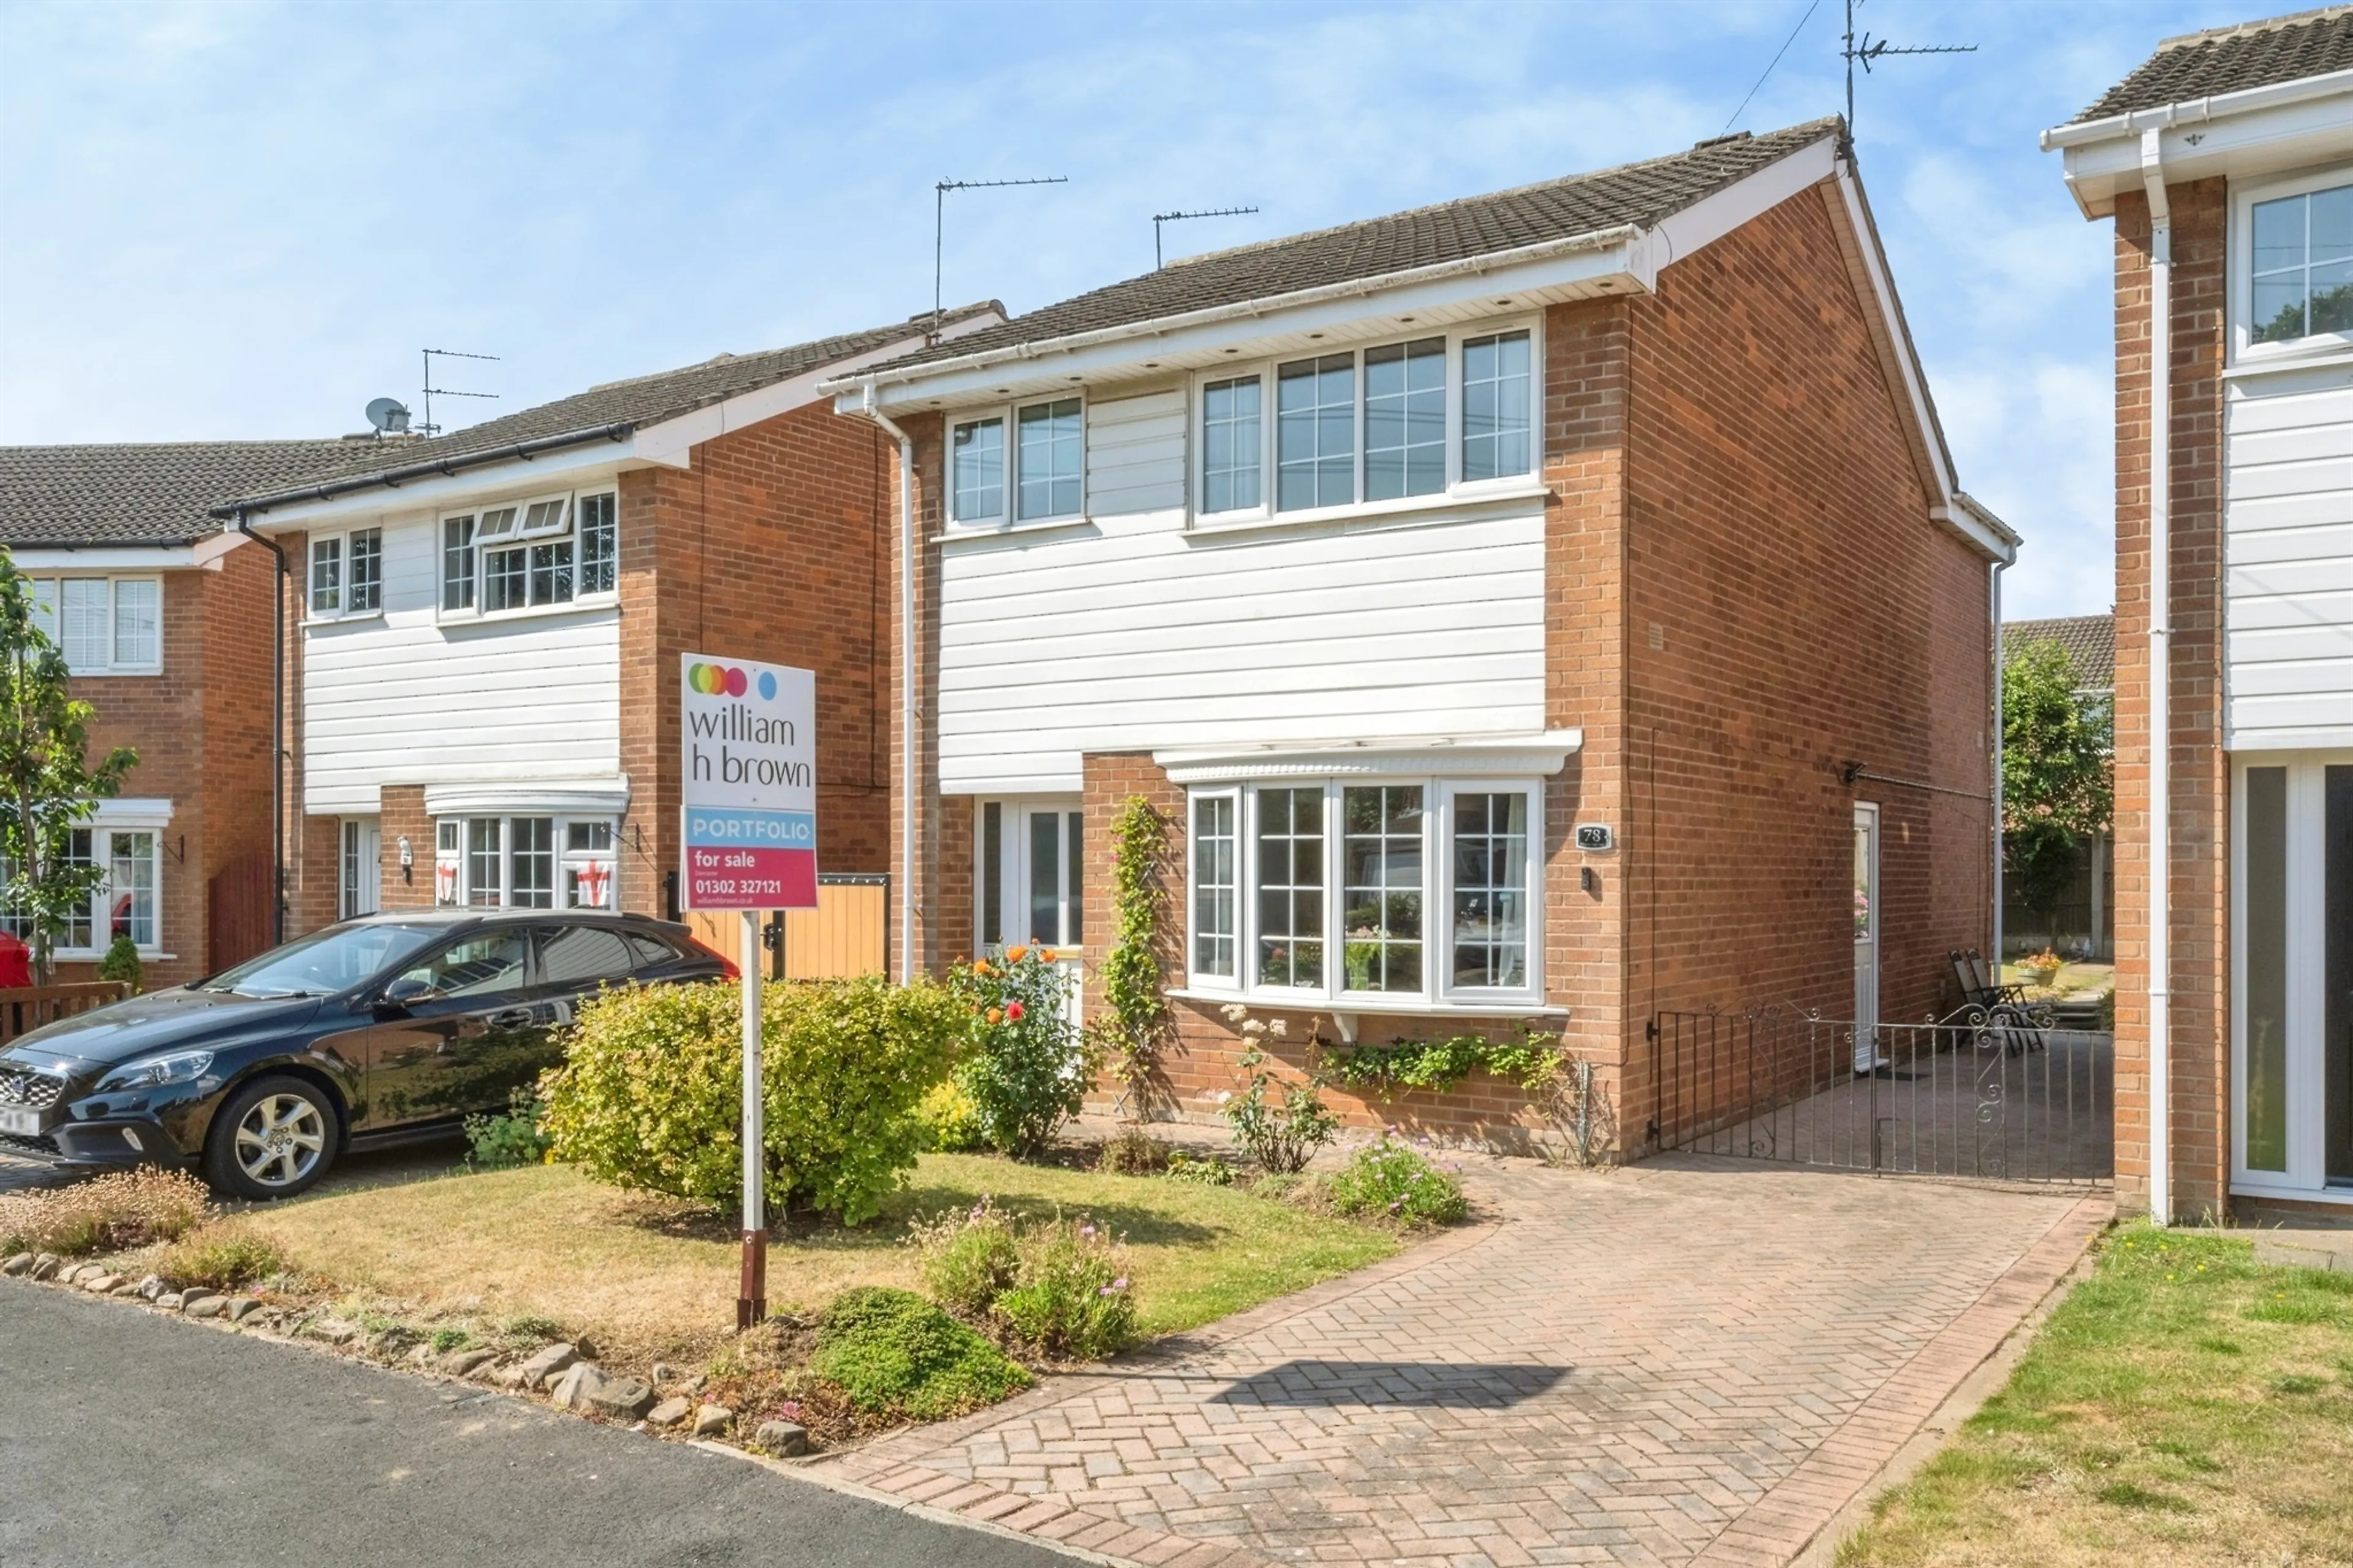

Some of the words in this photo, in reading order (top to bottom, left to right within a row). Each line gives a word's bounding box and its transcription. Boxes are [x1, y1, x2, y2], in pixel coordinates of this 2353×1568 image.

[689, 703, 794, 746] william
[693, 743, 710, 781] h
[722, 745, 810, 787] brown
[693, 819, 810, 840] PORTFOLIO
[1584, 829, 1601, 842] 78
[695, 850, 720, 867] for
[724, 851, 755, 867] sale
[696, 880, 735, 894] 01302
[740, 880, 781, 894] 327121
